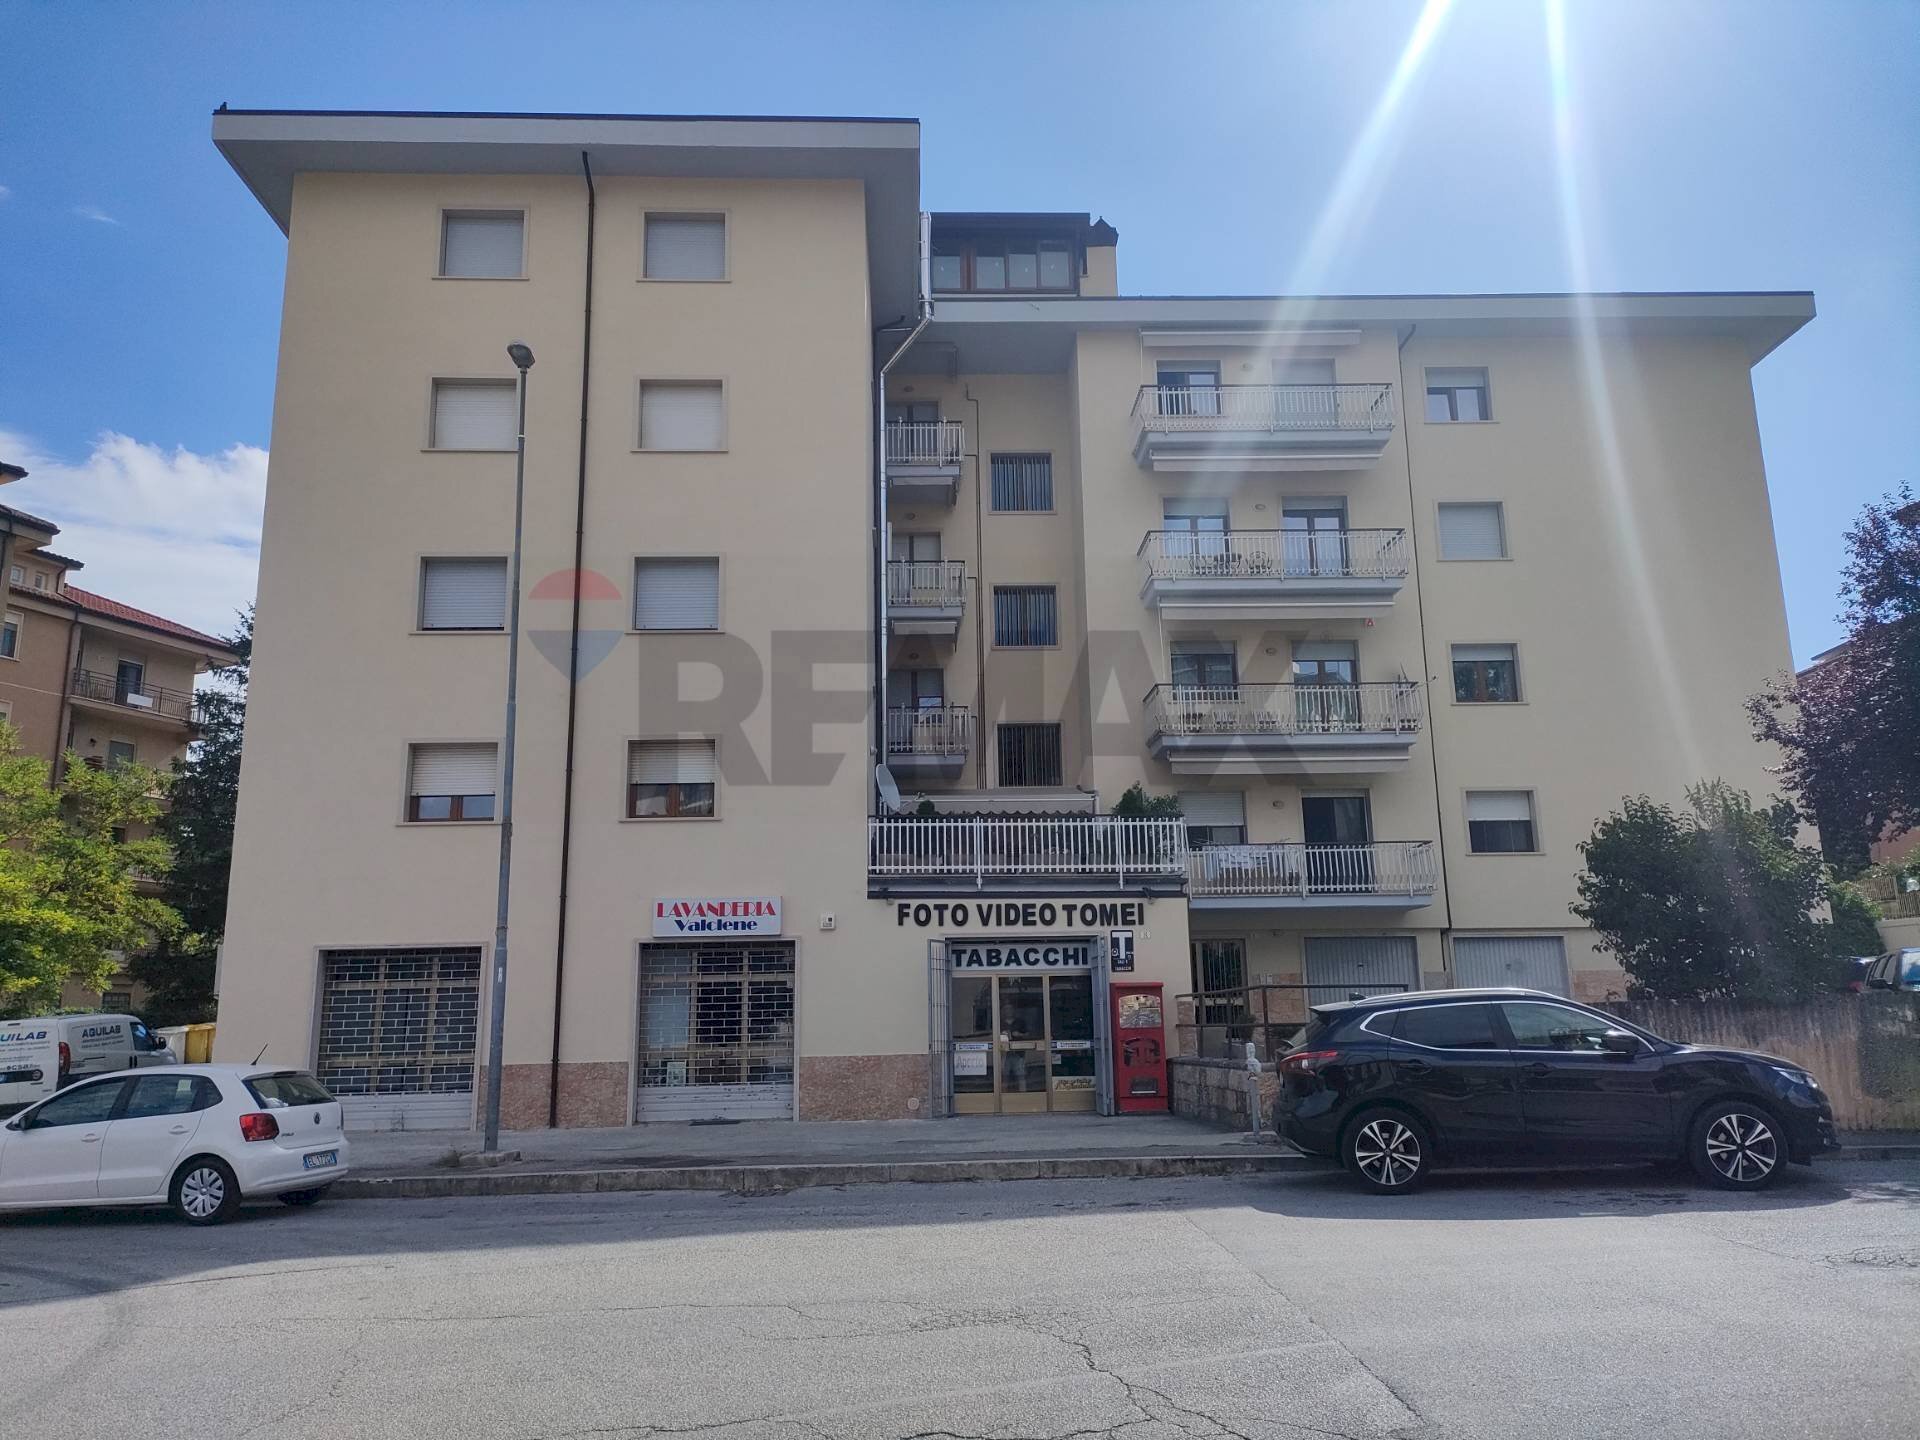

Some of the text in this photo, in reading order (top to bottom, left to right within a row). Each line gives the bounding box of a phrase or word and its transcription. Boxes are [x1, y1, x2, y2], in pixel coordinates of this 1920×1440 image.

[656, 901, 776, 918] LAVANDERIA
[898, 902, 1145, 927] FOTO VIDEO TOMEI
[674, 919, 758, 932] Valclene
[952, 947, 1088, 967] TABACCHI
